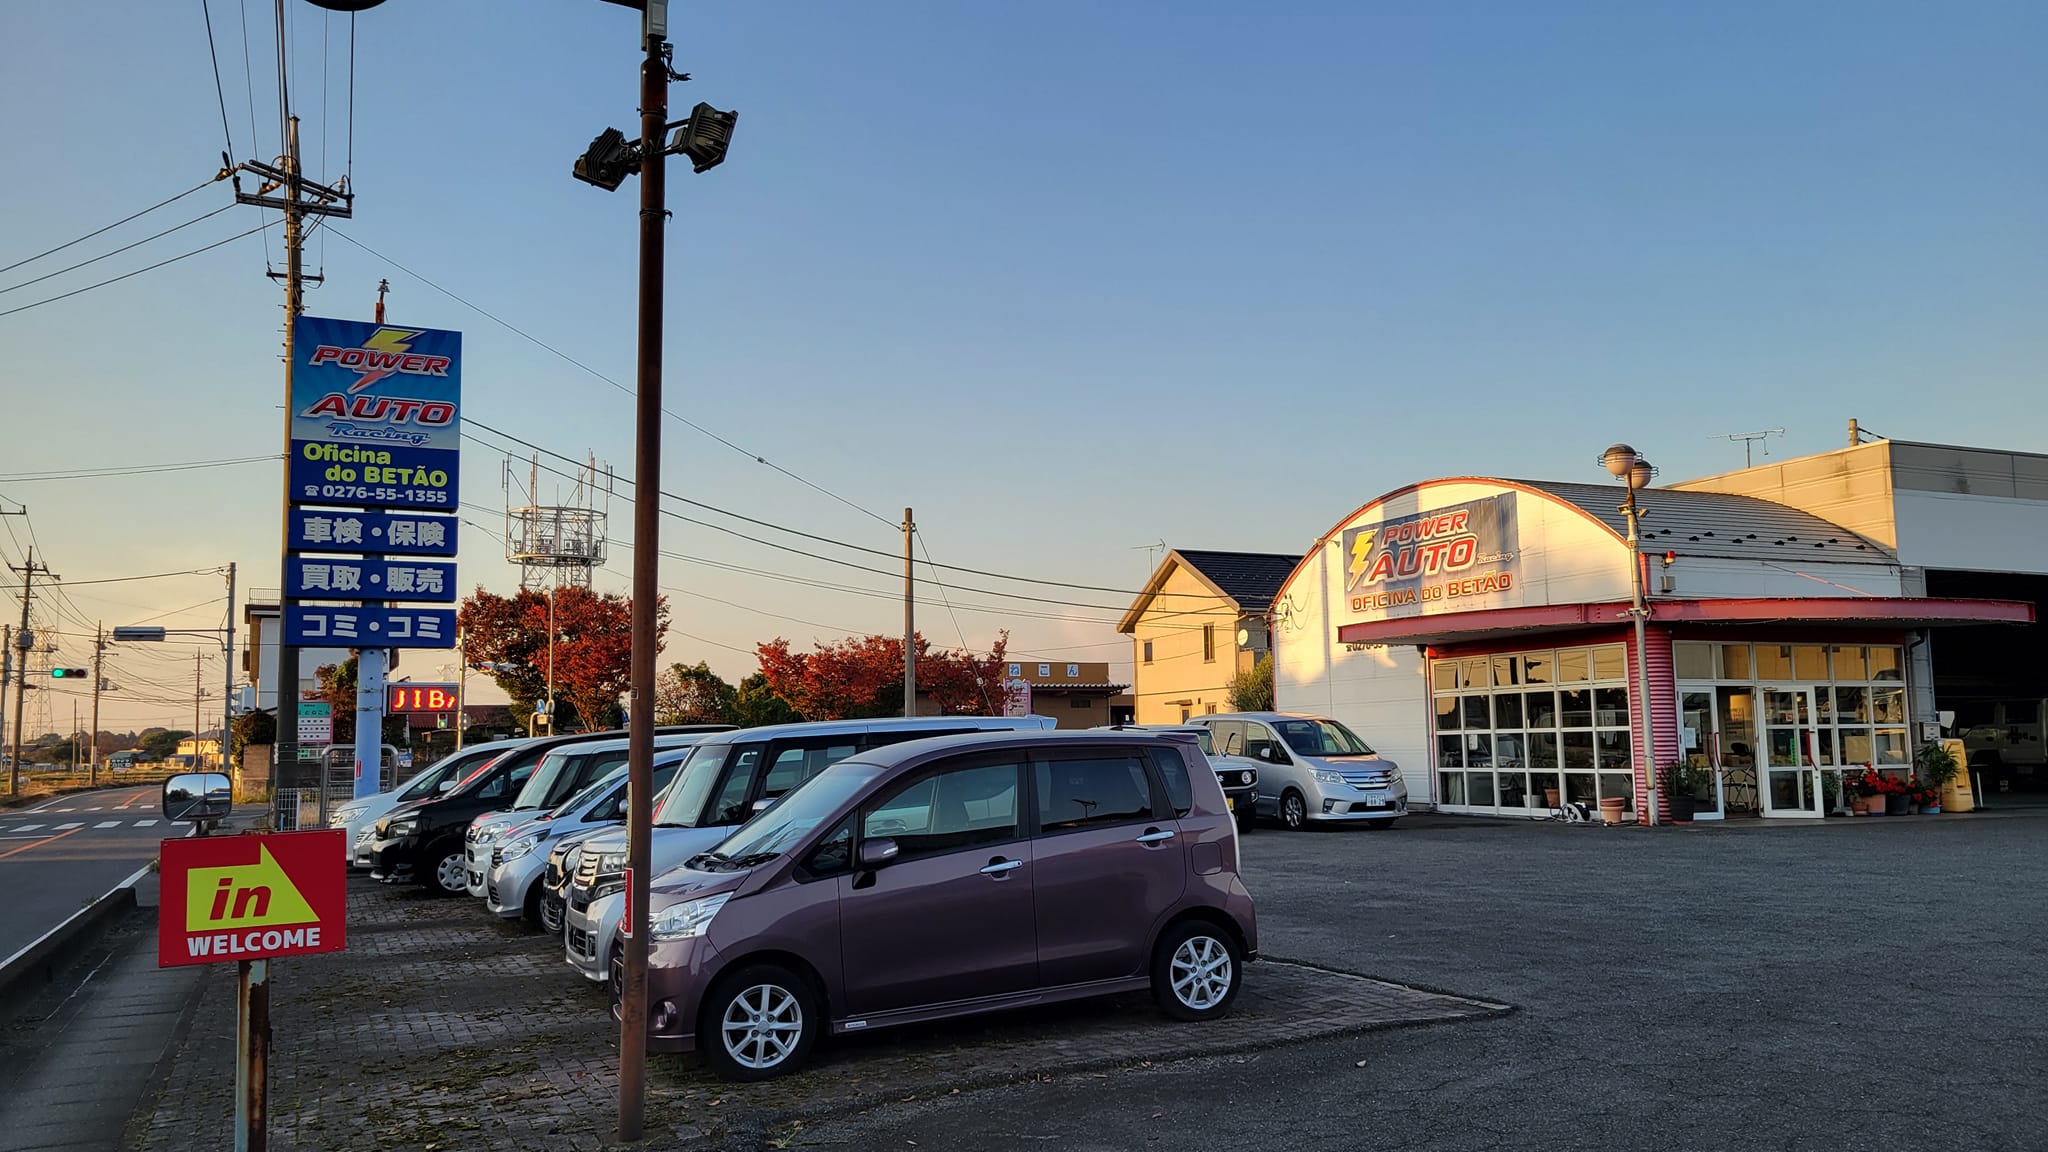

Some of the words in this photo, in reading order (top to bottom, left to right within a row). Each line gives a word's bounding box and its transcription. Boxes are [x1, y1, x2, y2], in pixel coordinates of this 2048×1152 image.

[308, 345, 452, 377] POWER
[299, 392, 457, 427] AUTO
[326, 422, 431, 446] Racing
[303, 443, 391, 464] Oficina
[325, 464, 356, 482] do
[364, 465, 448, 487] BETÃO
[322, 485, 447, 503] 0276-55-1355
[302, 516, 446, 547] 車検・保険
[1381, 509, 1470, 549] POWER
[1362, 533, 1478, 587] AUTO
[1477, 551, 1514, 565] Racing
[301, 564, 444, 593] 買取・販売
[1351, 587, 1417, 612] OFICINA
[1420, 585, 1442, 602] DO
[1446, 570, 1513, 600] BETÃO
[302, 614, 441, 639] コミ・コミ
[209, 877, 272, 920] in
[187, 927, 321, 957] WELCOME
